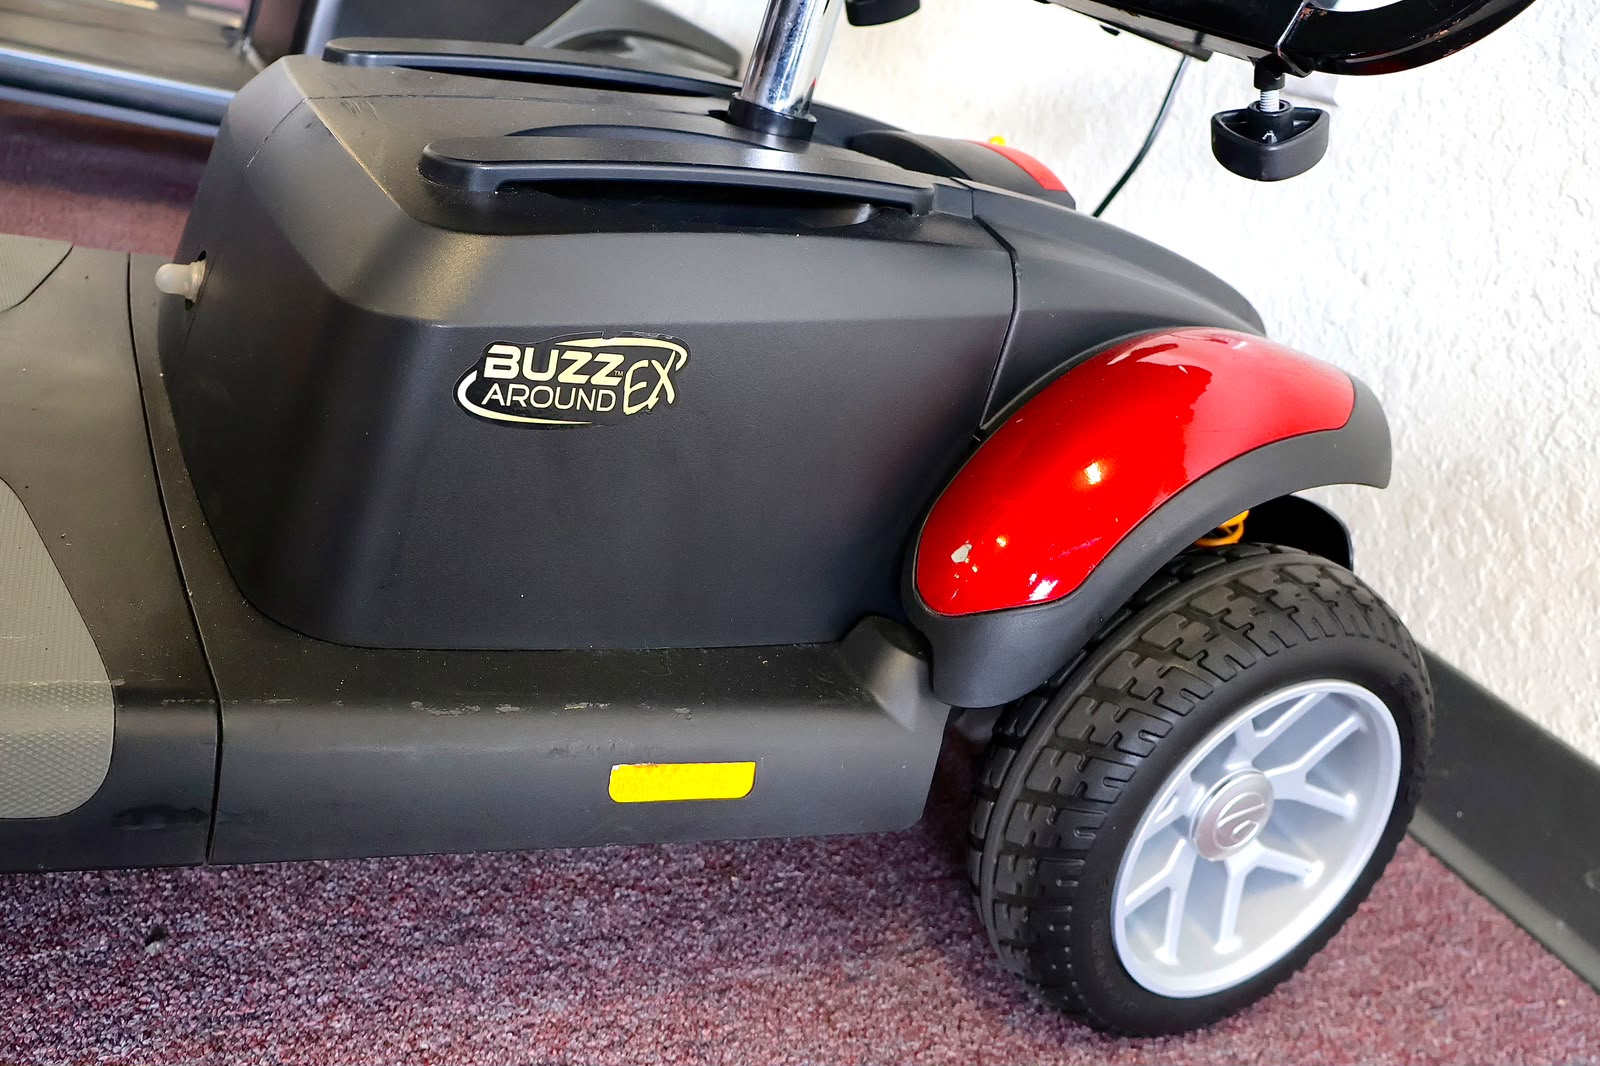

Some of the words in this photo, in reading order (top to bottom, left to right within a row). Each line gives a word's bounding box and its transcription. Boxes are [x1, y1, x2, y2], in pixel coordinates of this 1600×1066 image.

[484, 345, 625, 386] BUZZ
[623, 351, 676, 415] EX
[481, 383, 617, 412] AROUND
